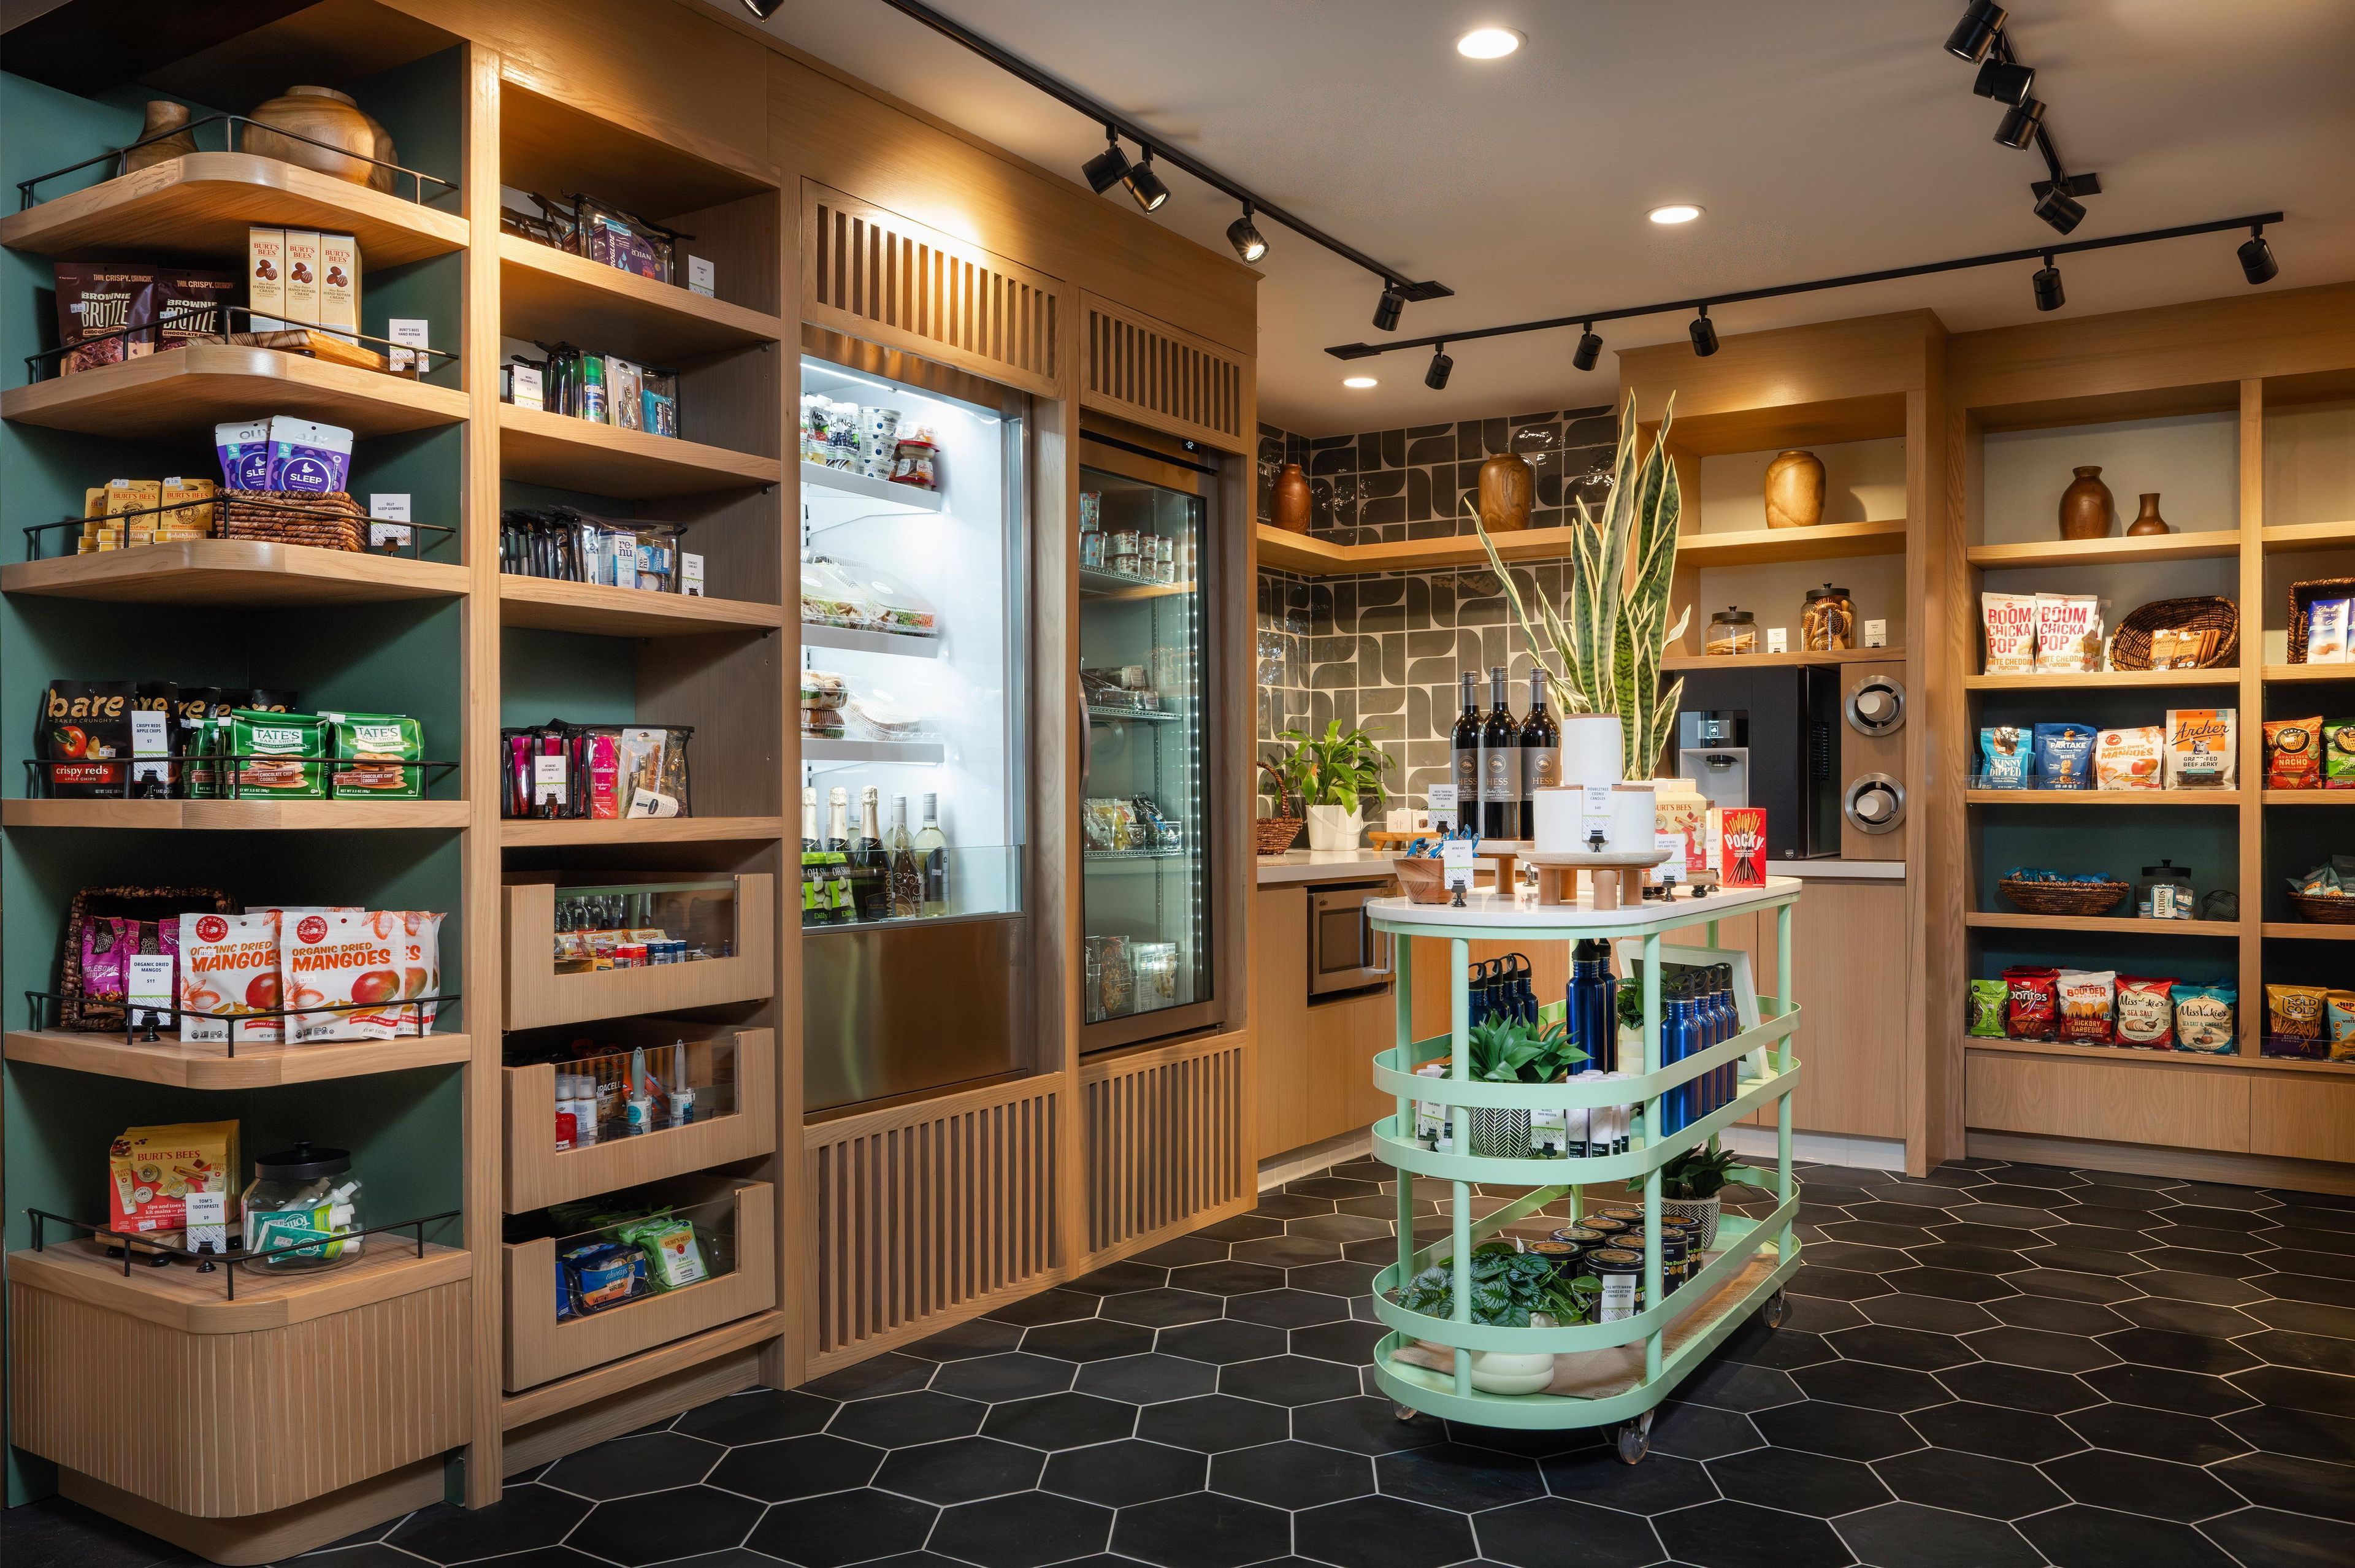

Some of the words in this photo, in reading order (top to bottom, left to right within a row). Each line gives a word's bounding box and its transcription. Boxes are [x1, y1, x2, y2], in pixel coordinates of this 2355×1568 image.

[81, 291, 131, 300] BROWNIE
[81, 300, 129, 327] BRITTLE
[289, 473, 323, 484] SLEEP
[1988, 608, 2031, 624] BOOM
[2042, 607, 2087, 624] BOOM
[1988, 624, 2031, 637] CHICKA
[2040, 623, 2084, 635] CHICKA
[1989, 638, 2016, 654] POP
[2039, 636, 2069, 652] POP
[48, 689, 124, 717] bare
[255, 729, 299, 740] TATE'S
[356, 727, 398, 737] TATE'S
[2171, 719, 2229, 741] Archer
[1990, 759, 2022, 768] SKINNY
[56, 766, 82, 776] crispy
[85, 765, 108, 774] reds
[1989, 767, 2021, 776] DIPPED
[808, 868, 818, 878] OH
[833, 867, 840, 876] OH
[199, 919, 207, 934] MADE
[241, 941, 272, 951] DRIED
[292, 946, 338, 956] ORGANIC
[341, 942, 372, 952] DRIED
[293, 948, 391, 973] MANGOES
[2010, 991, 2047, 1001] Doritos
[2067, 987, 2106, 996] BOULDER
[2120, 995, 2137, 1006] Miss
[2180, 1005, 2199, 1016] Miss
[2287, 1006, 2316, 1014] GOLD
[597, 1082, 621, 1093] URACELL
[137, 1152, 172, 1161] BURT'S
[176, 1150, 201, 1159] BEES
[665, 1237, 680, 1247] BURT'S
[606, 1268, 628, 1280] always
